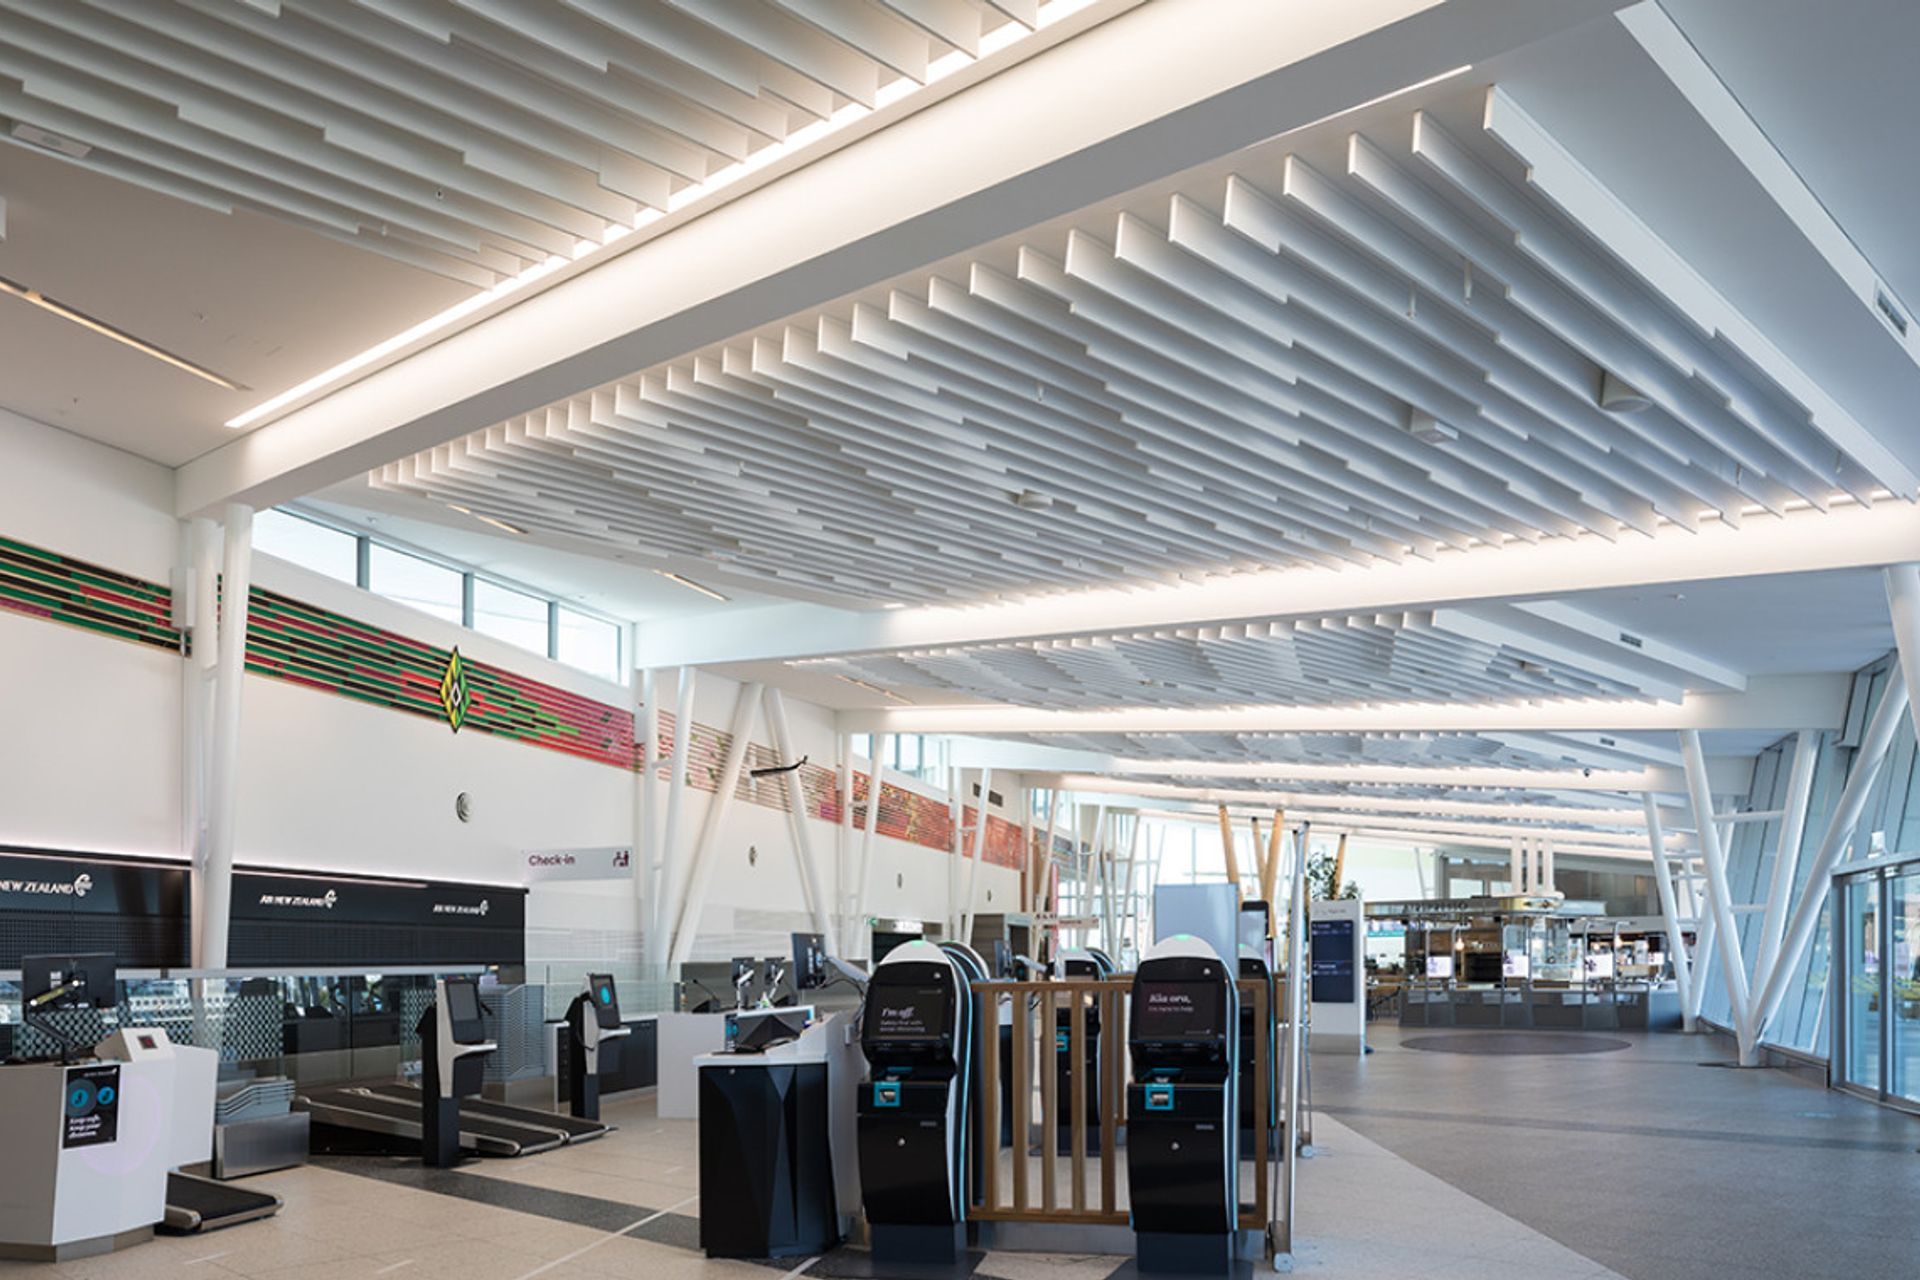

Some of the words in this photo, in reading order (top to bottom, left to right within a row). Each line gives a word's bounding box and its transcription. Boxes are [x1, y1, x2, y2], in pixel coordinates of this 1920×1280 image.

[528, 853, 576, 867] Check-in
[23, 881, 75, 895] ZEALAND
[260, 894, 273, 905] AIR
[274, 895, 292, 906] NEW
[290, 896, 325, 907] ZEALAND
